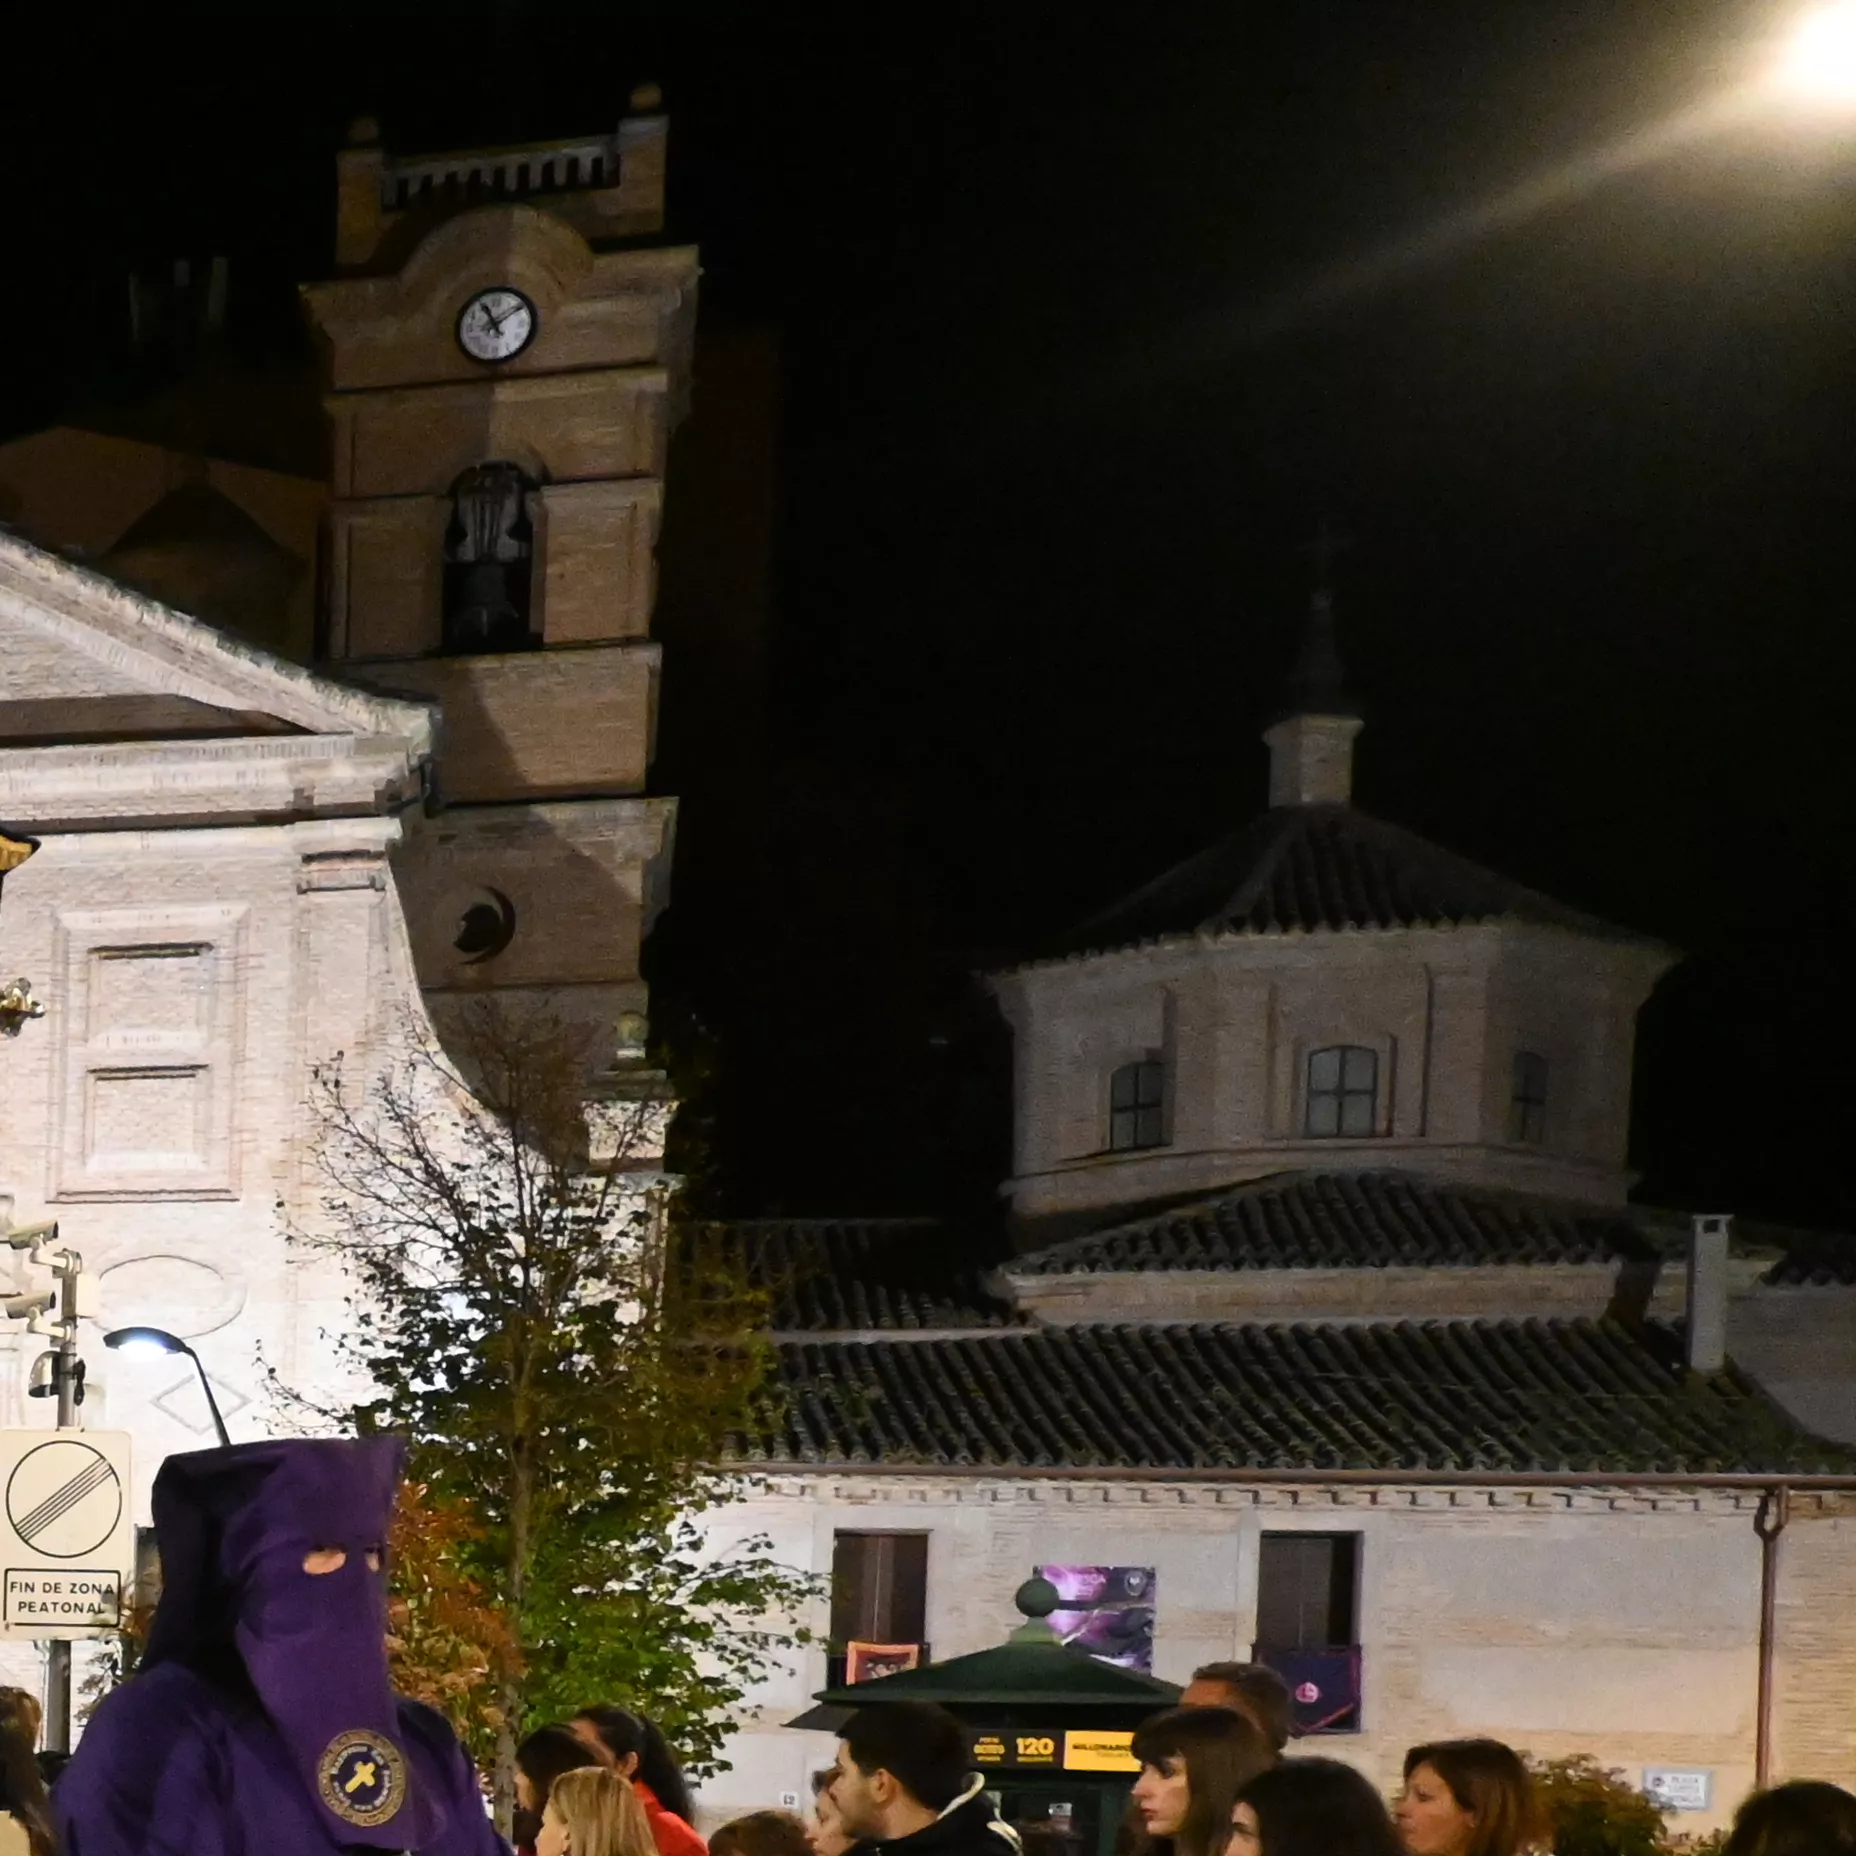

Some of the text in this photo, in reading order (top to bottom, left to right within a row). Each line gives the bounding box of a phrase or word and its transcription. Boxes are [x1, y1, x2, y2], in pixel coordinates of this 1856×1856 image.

[10, 1581, 115, 1595] FIN DE ZONA
[17, 1601, 106, 1614] PEATONAL
[1015, 1736, 1055, 1756] 120
